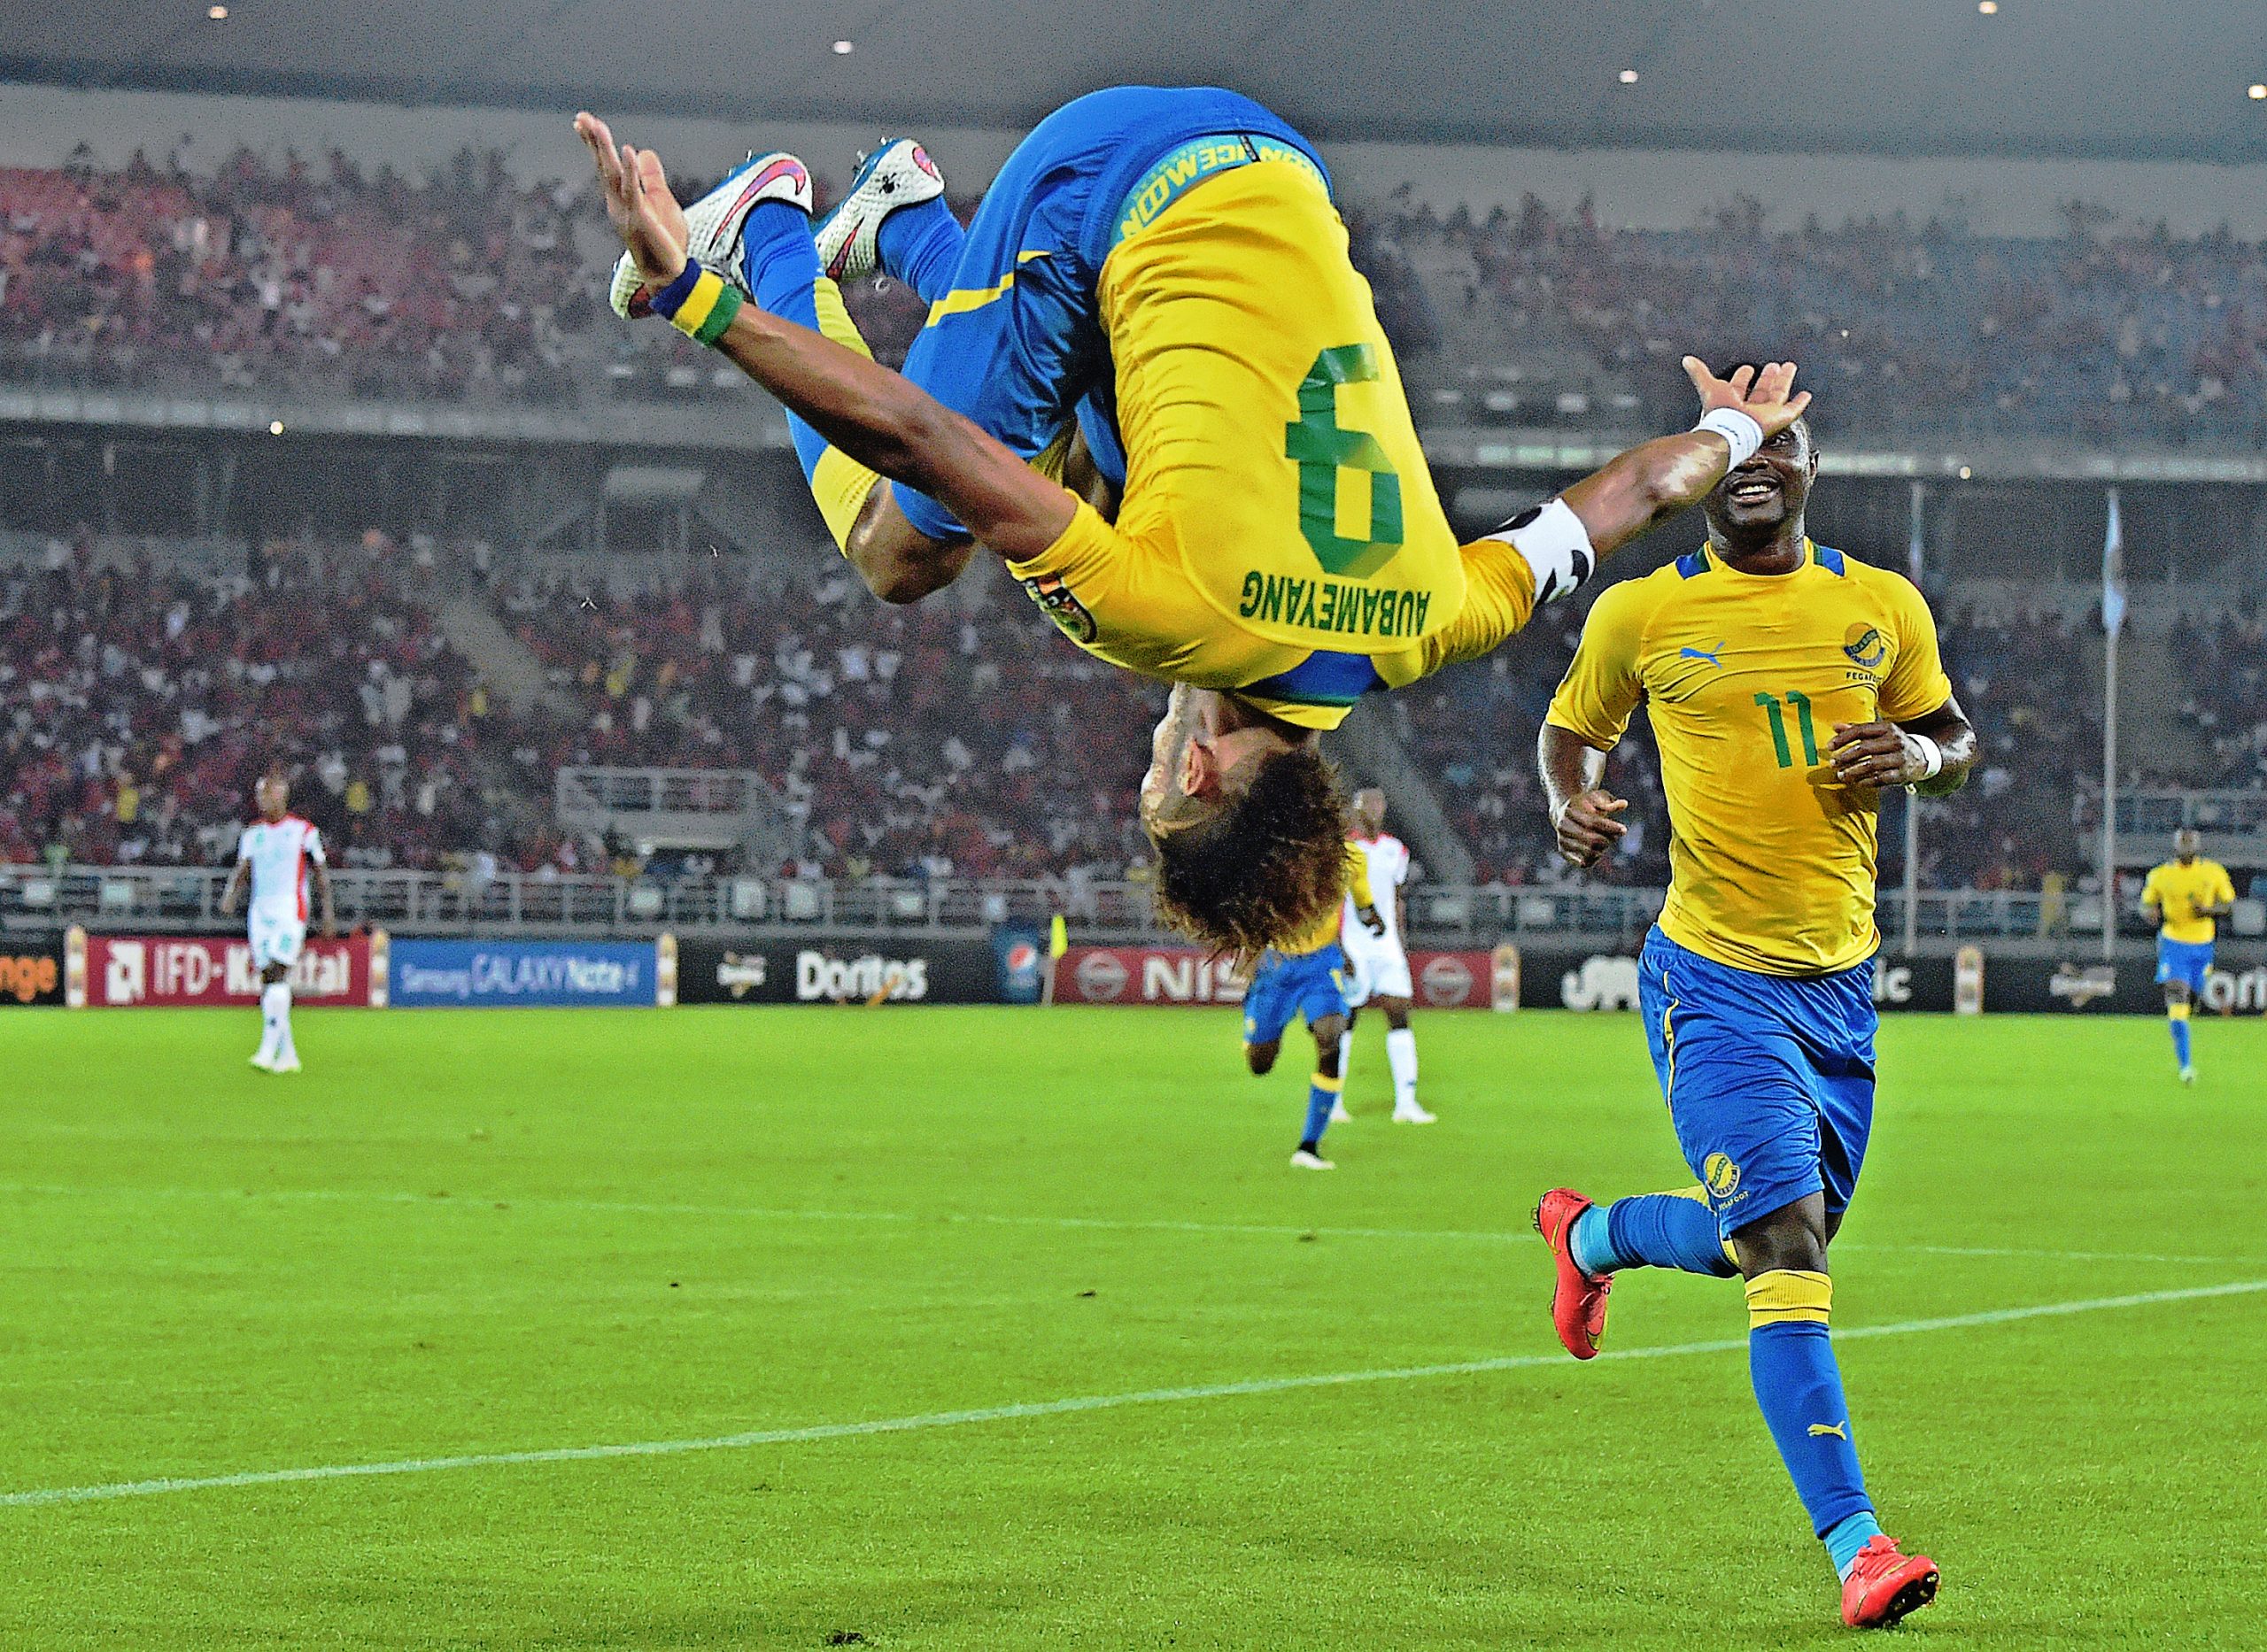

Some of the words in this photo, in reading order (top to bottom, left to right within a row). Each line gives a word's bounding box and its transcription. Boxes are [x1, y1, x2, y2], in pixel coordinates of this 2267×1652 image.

[1285, 344, 1404, 580] 9
[1239, 569, 1432, 637] AUBAMEYANG
[1753, 690, 1819, 768] 11
[797, 950, 928, 1001] Doritos
[1143, 954, 1248, 1001] NIS
